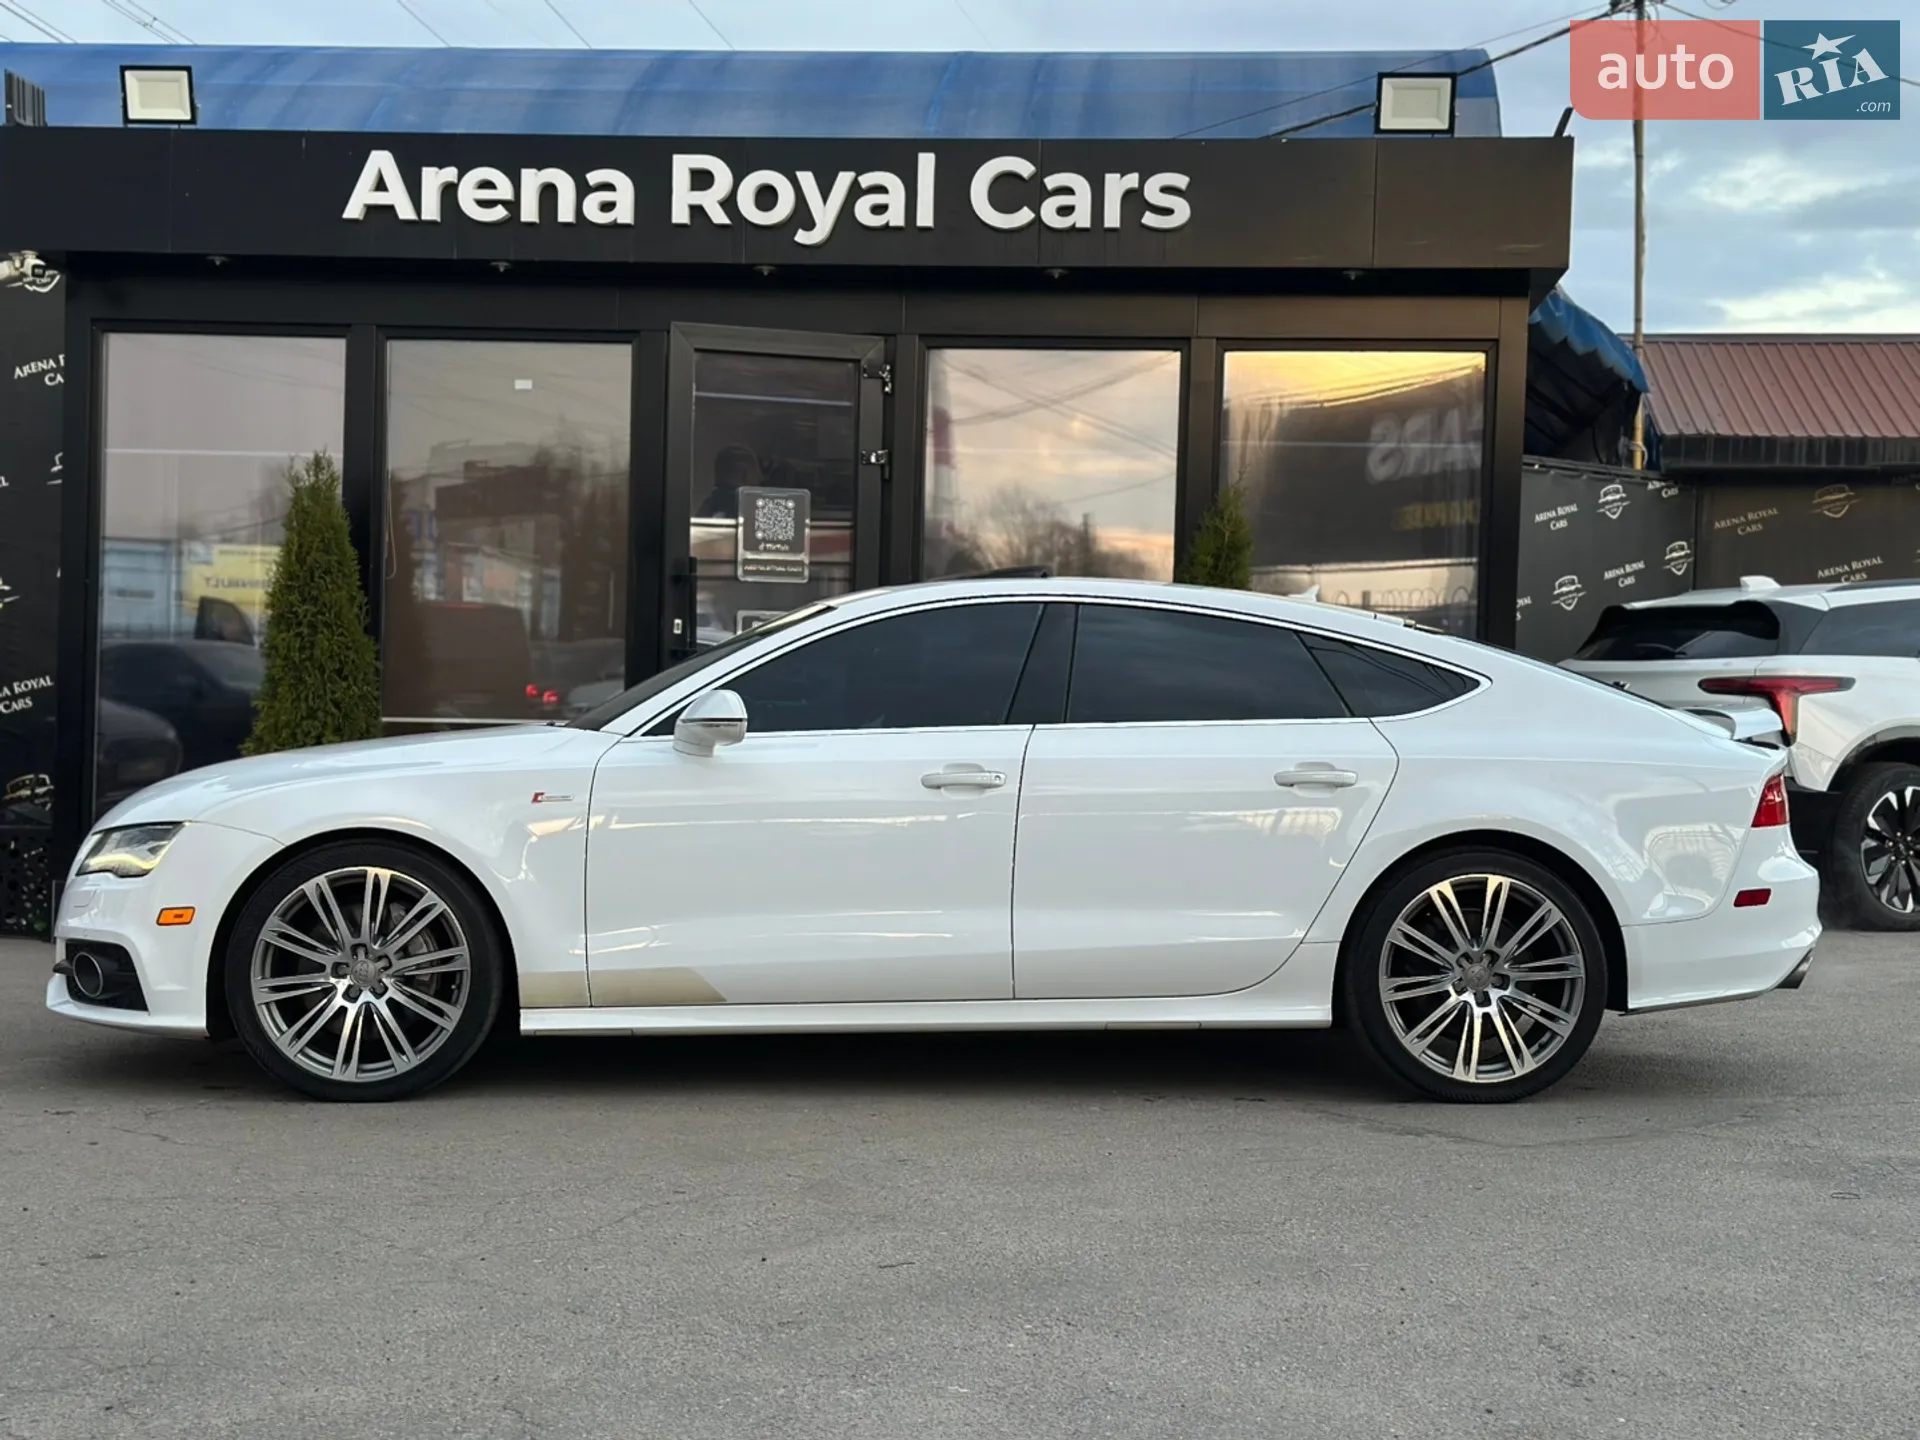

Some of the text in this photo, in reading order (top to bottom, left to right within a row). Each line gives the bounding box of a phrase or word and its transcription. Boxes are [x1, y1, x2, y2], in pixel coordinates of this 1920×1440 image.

[342, 150, 1191, 246] Arena Royal Cars
[14, 358, 57, 379] ARENA
[1534, 509, 1558, 523] ARENA
[1550, 518, 1568, 530] CARS
[1714, 507, 1779, 529] ARENA ROYAL
[1737, 522, 1763, 536] CARS
[1603, 565, 1625, 580] ARENA
[1817, 556, 1884, 579] ARENA ROYAL
[1618, 575, 1636, 588] CARS
[13, 675, 54, 695] ROYAL
[0, 696, 33, 714] CARS
